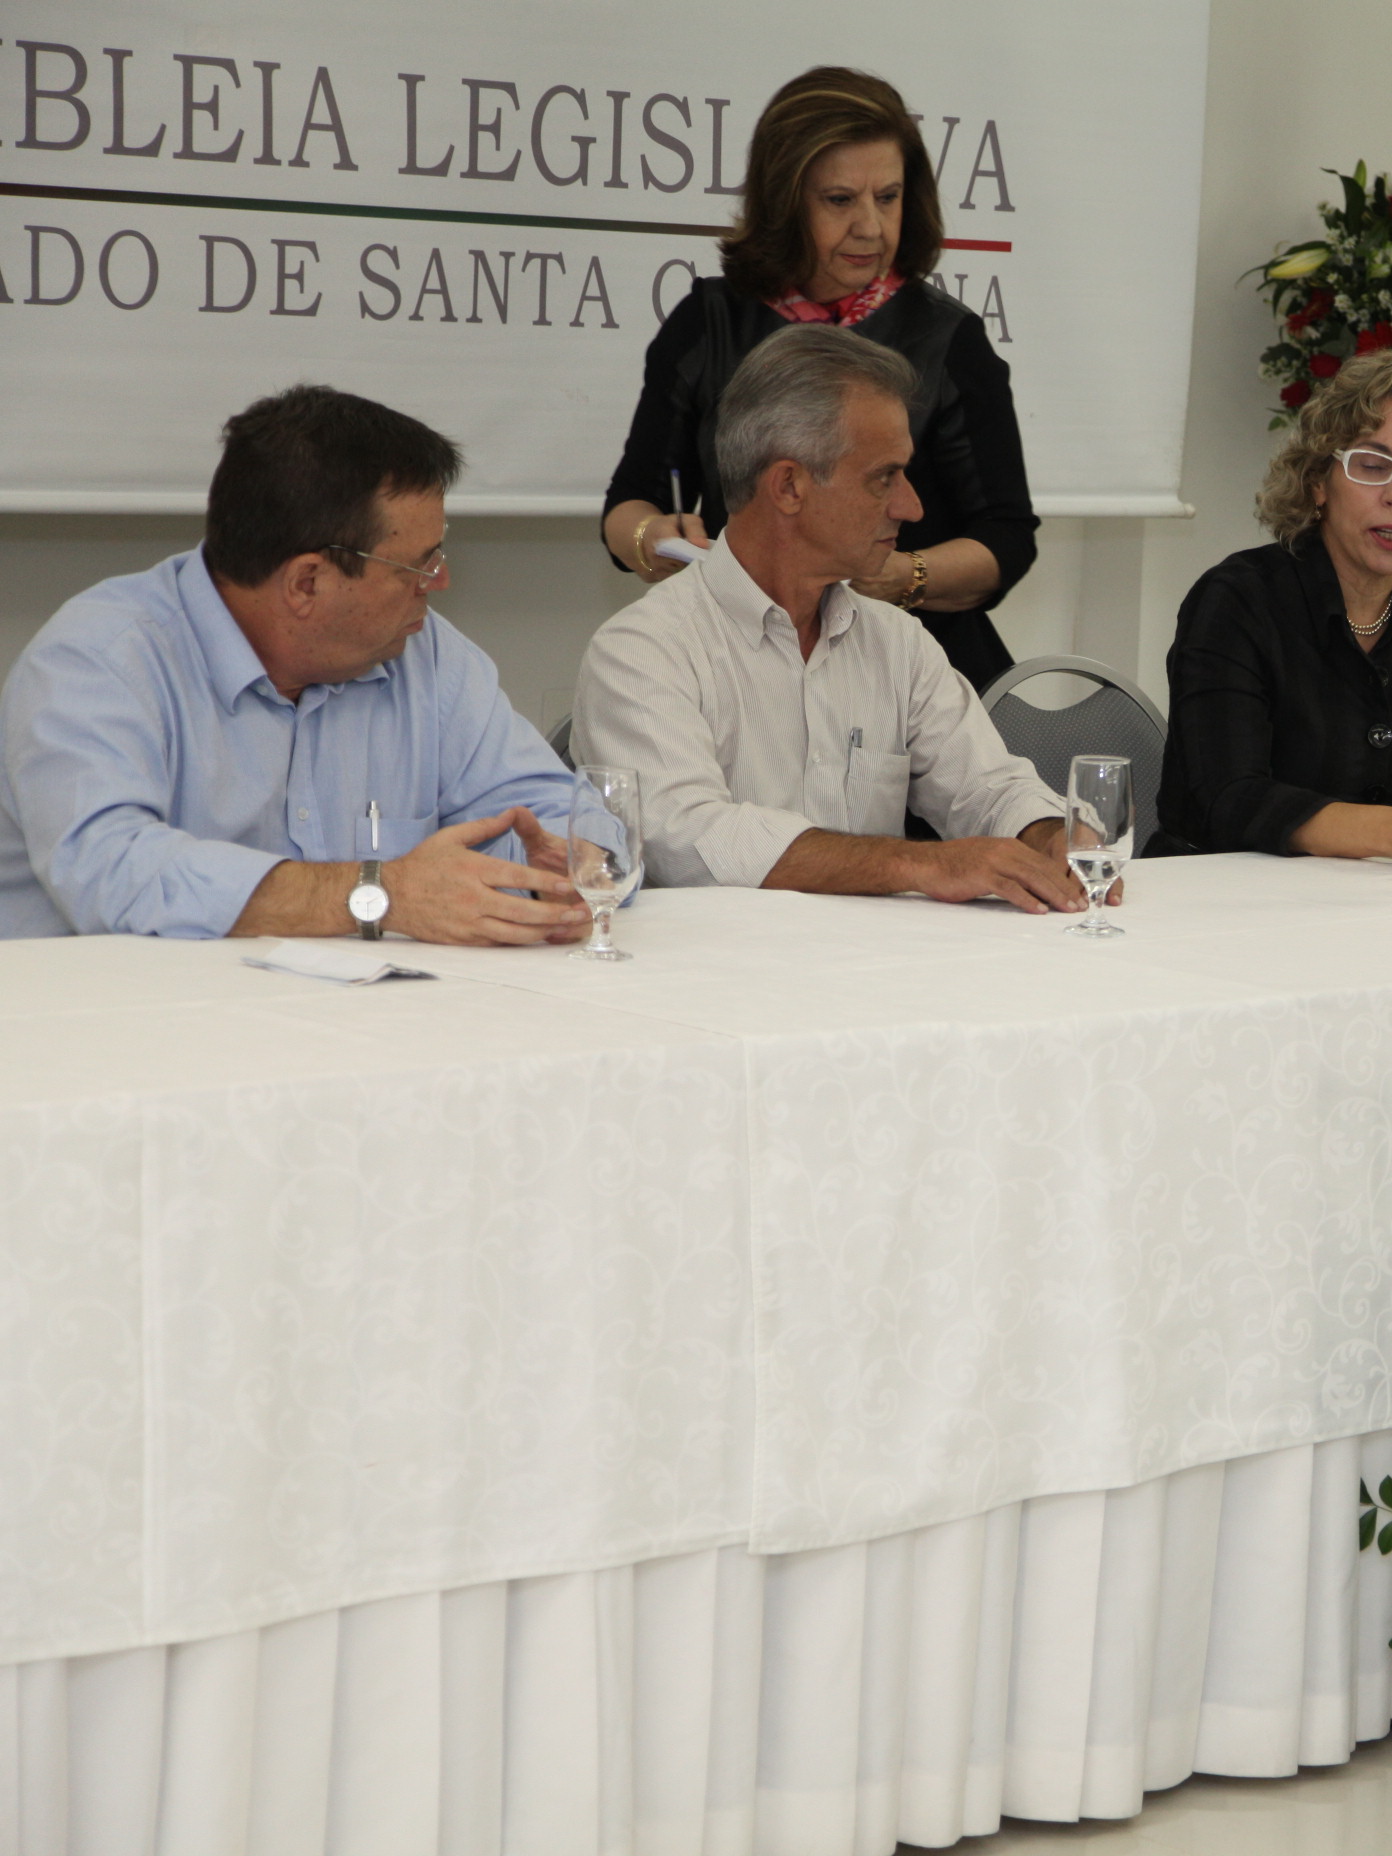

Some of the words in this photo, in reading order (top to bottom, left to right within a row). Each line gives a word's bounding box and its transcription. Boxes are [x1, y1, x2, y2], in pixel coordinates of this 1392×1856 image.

[0, 38, 359, 172] BLEIA
[397, 72, 1016, 213] LEGISLA
[0, 224, 160, 311] DO
[198, 234, 323, 318] DE
[358, 243, 620, 329] SANTA
